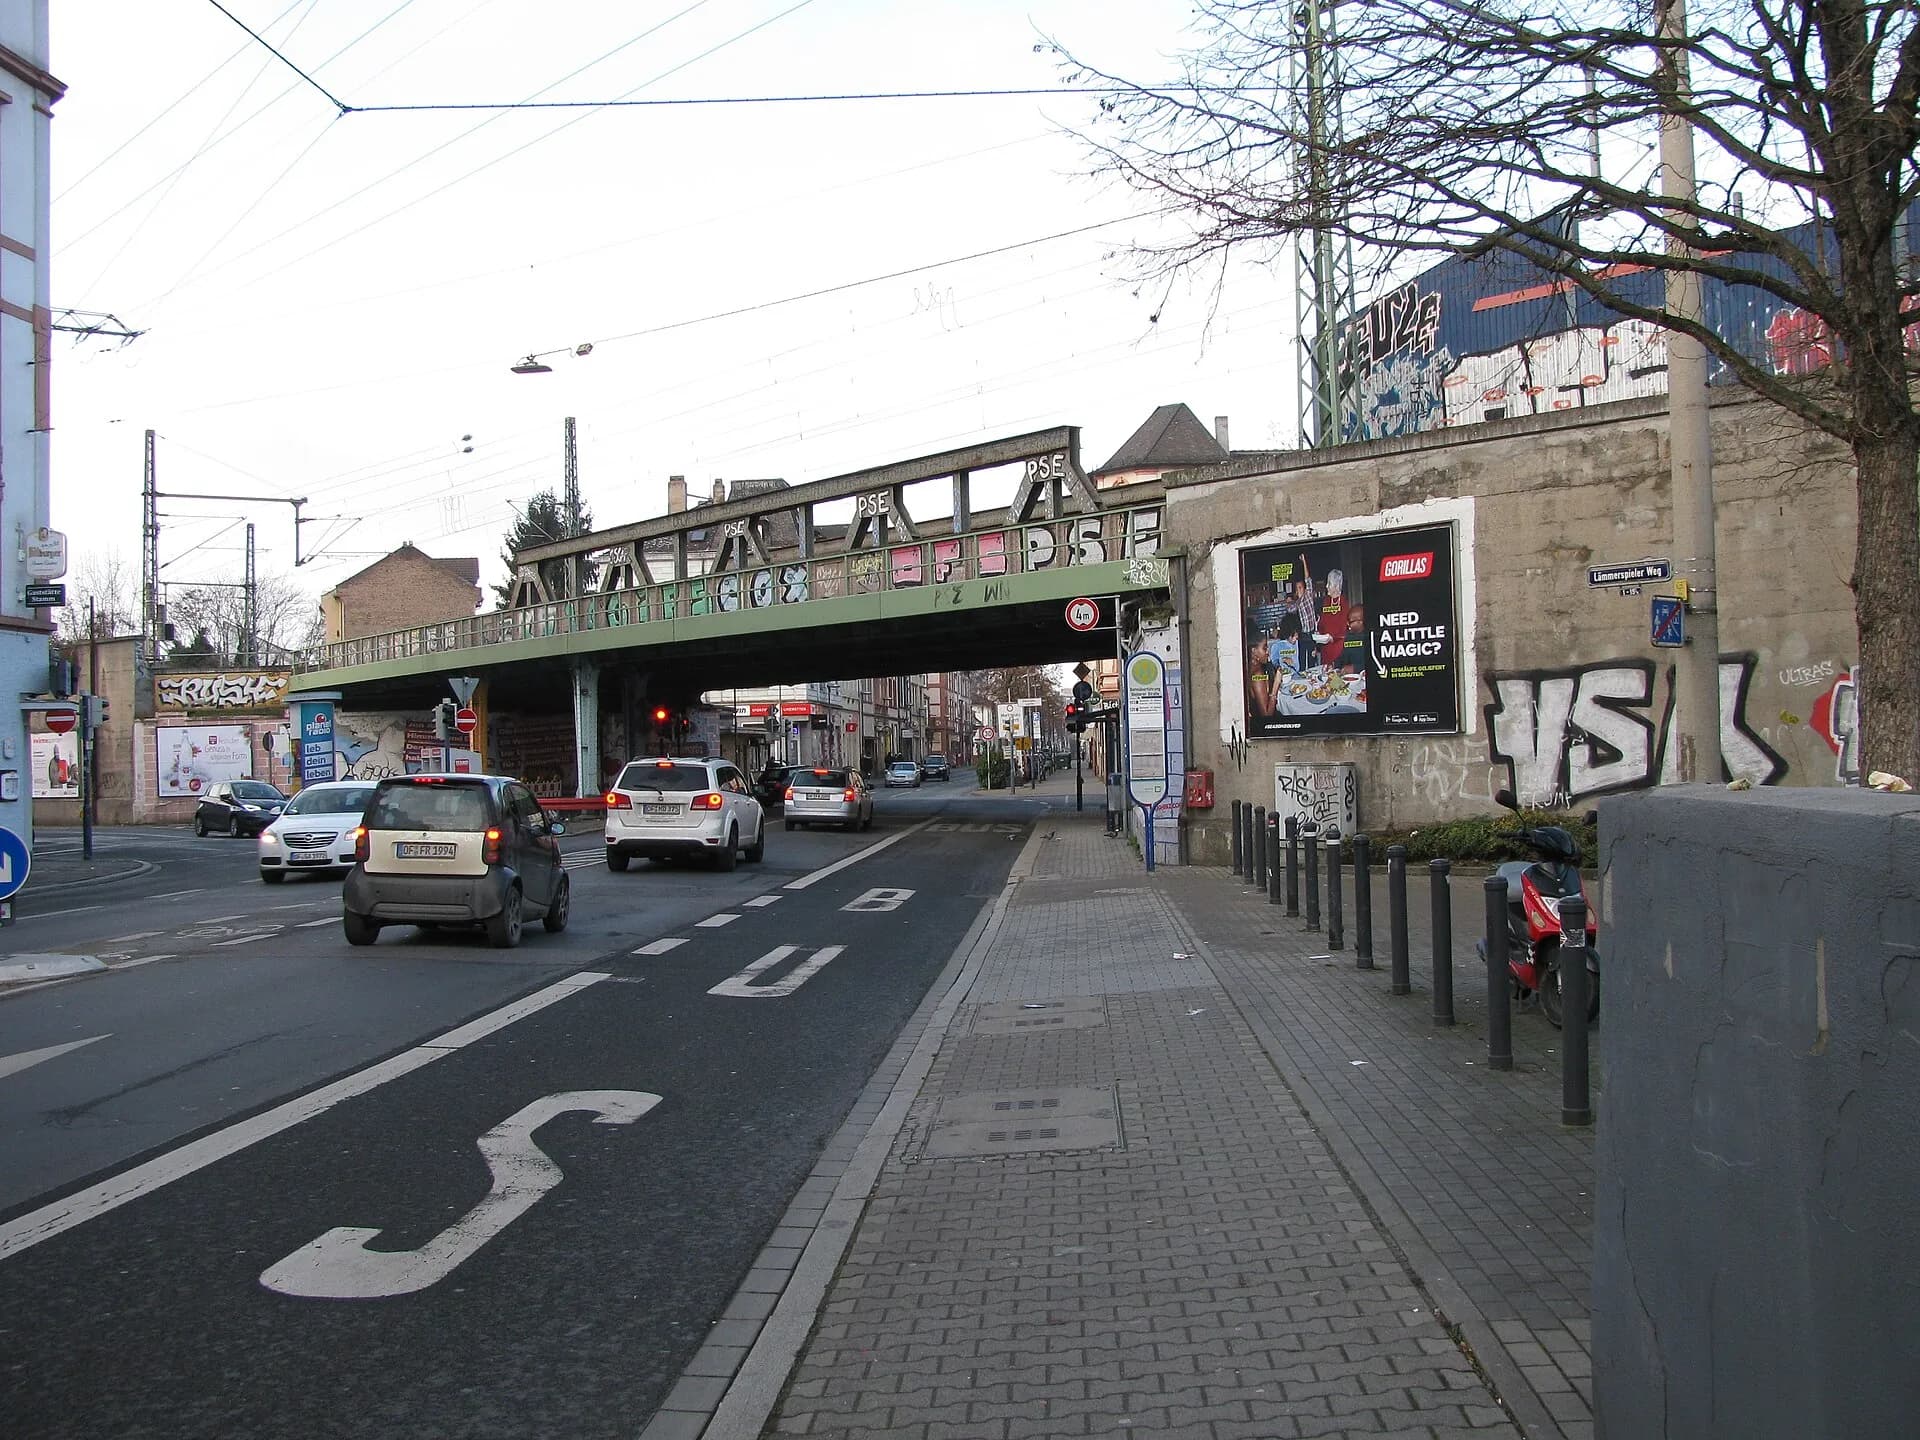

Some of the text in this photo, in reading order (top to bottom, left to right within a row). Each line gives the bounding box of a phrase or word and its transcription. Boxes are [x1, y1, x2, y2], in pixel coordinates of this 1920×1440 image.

[1026, 454, 1065, 482] PSE
[857, 490, 890, 518] PSE
[1384, 557, 1428, 577] GORILLAS
[1593, 565, 1662, 582] Lämmerspieler Weg
[1380, 611, 1419, 627] NEED
[1380, 625, 1445, 642] A LITTLE
[1380, 642, 1442, 659] MAGIC?
[1779, 660, 1834, 685] ULTRAS
[306, 744, 321, 754] leb
[306, 756, 327, 766] dein
[306, 769, 331, 779] leben
[403, 845, 454, 857] OF FR 1994
